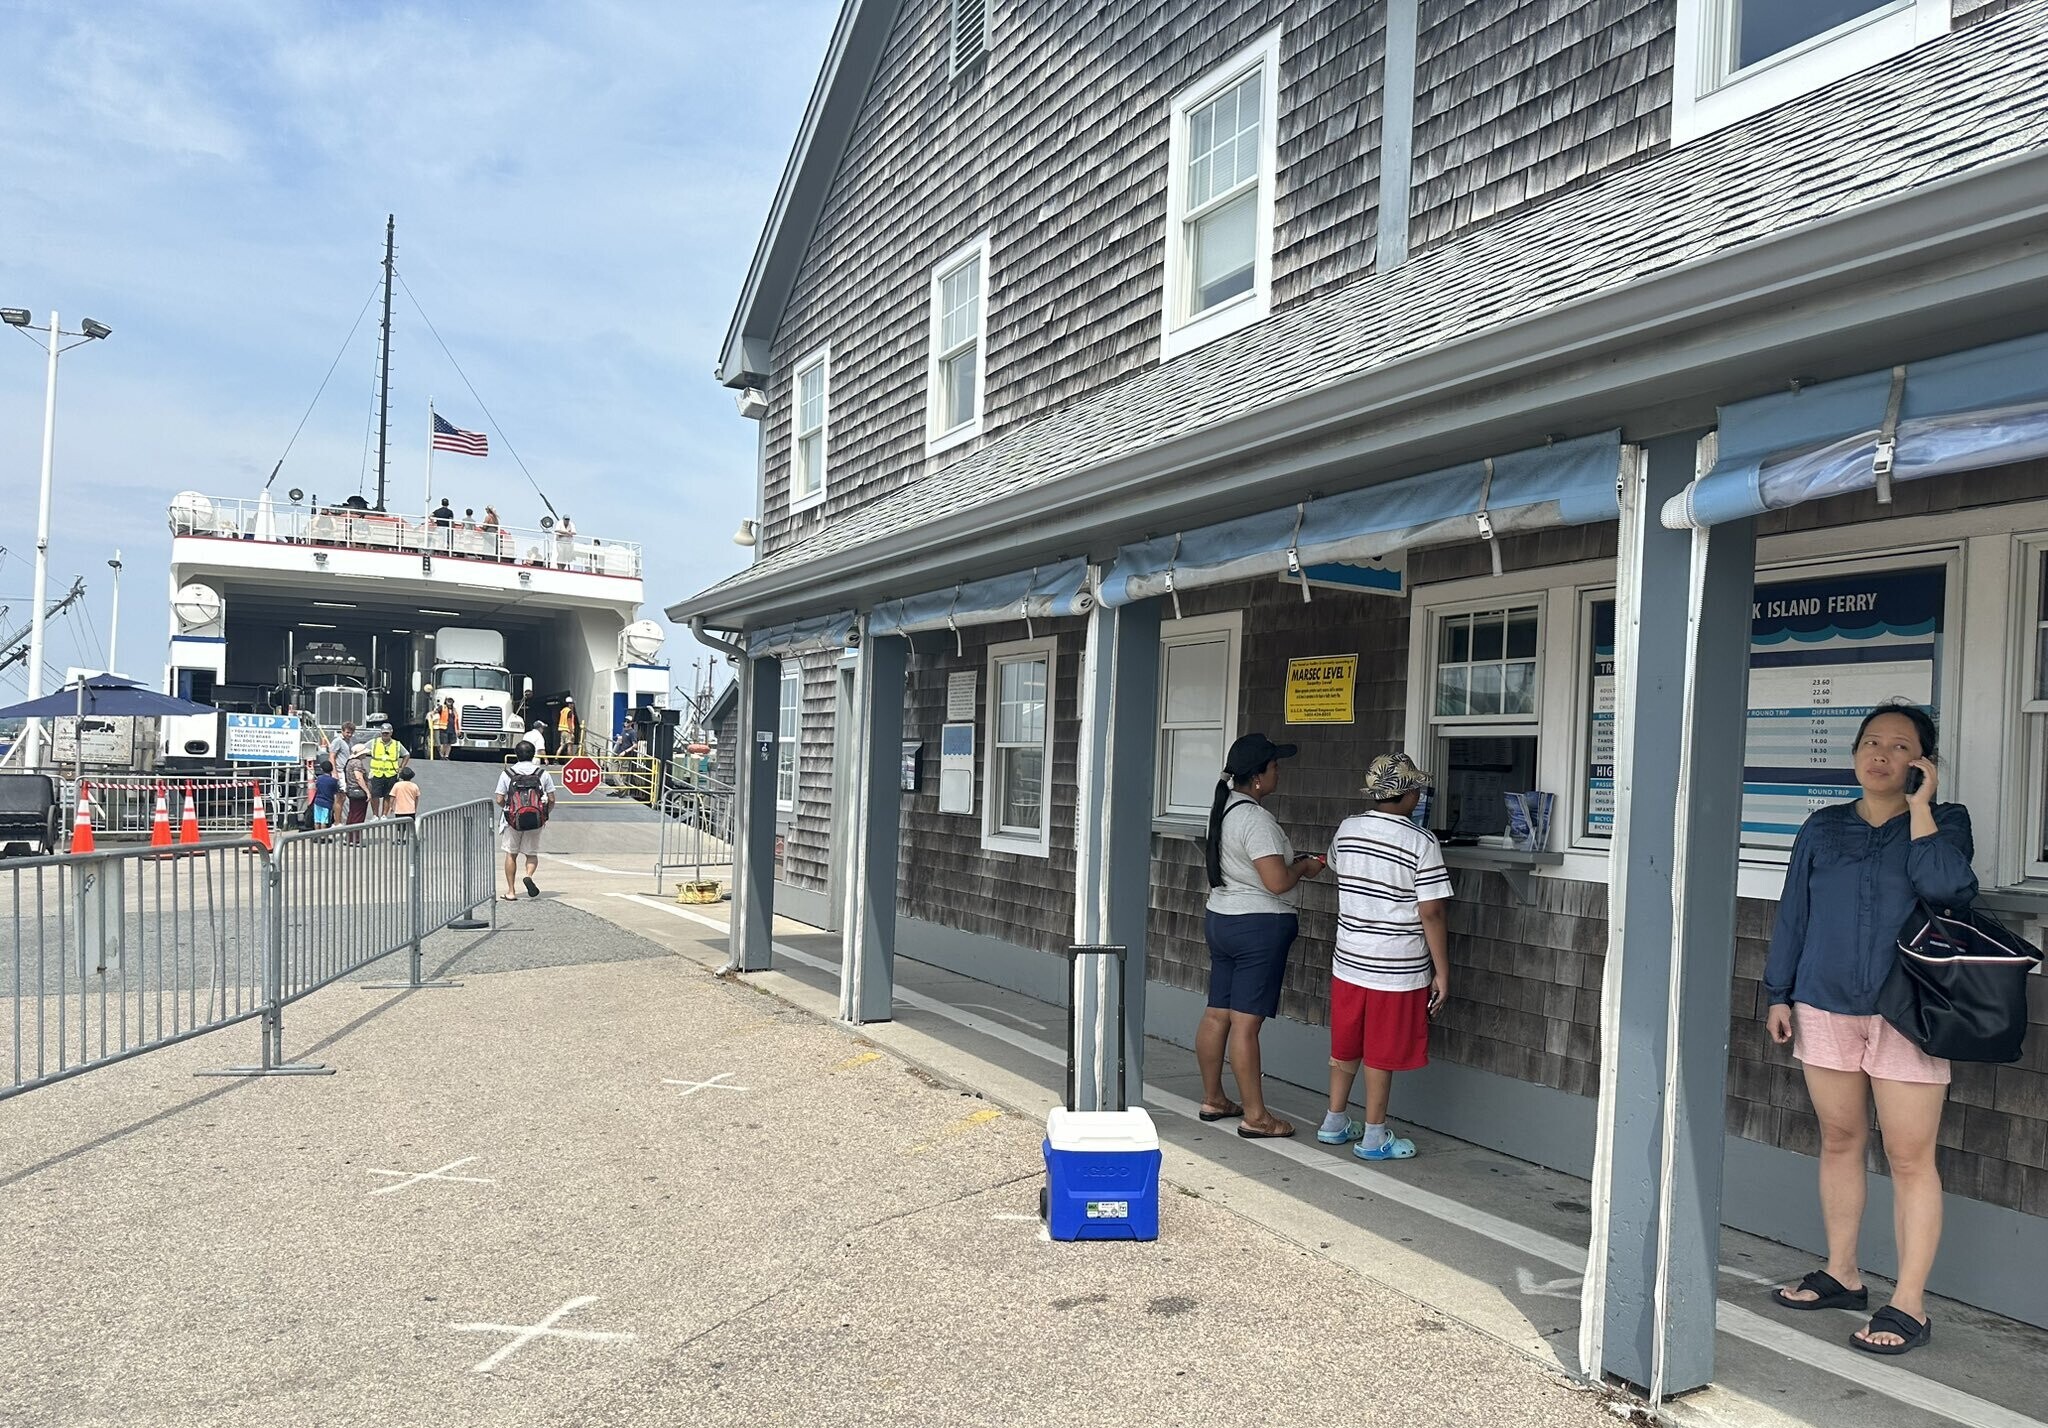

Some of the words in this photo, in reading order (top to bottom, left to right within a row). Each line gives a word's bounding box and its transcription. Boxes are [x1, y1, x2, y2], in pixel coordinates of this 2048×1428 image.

[1767, 598, 1821, 618] ISLAND
[1828, 593, 1878, 613] FERRY
[1292, 667, 1321, 681] MARSEC
[1323, 666, 1344, 679] LEVEL
[1348, 666, 1352, 678] 1
[238, 716, 275, 728] SLIP
[282, 718, 291, 728] 2
[565, 769, 598, 783] STOP
